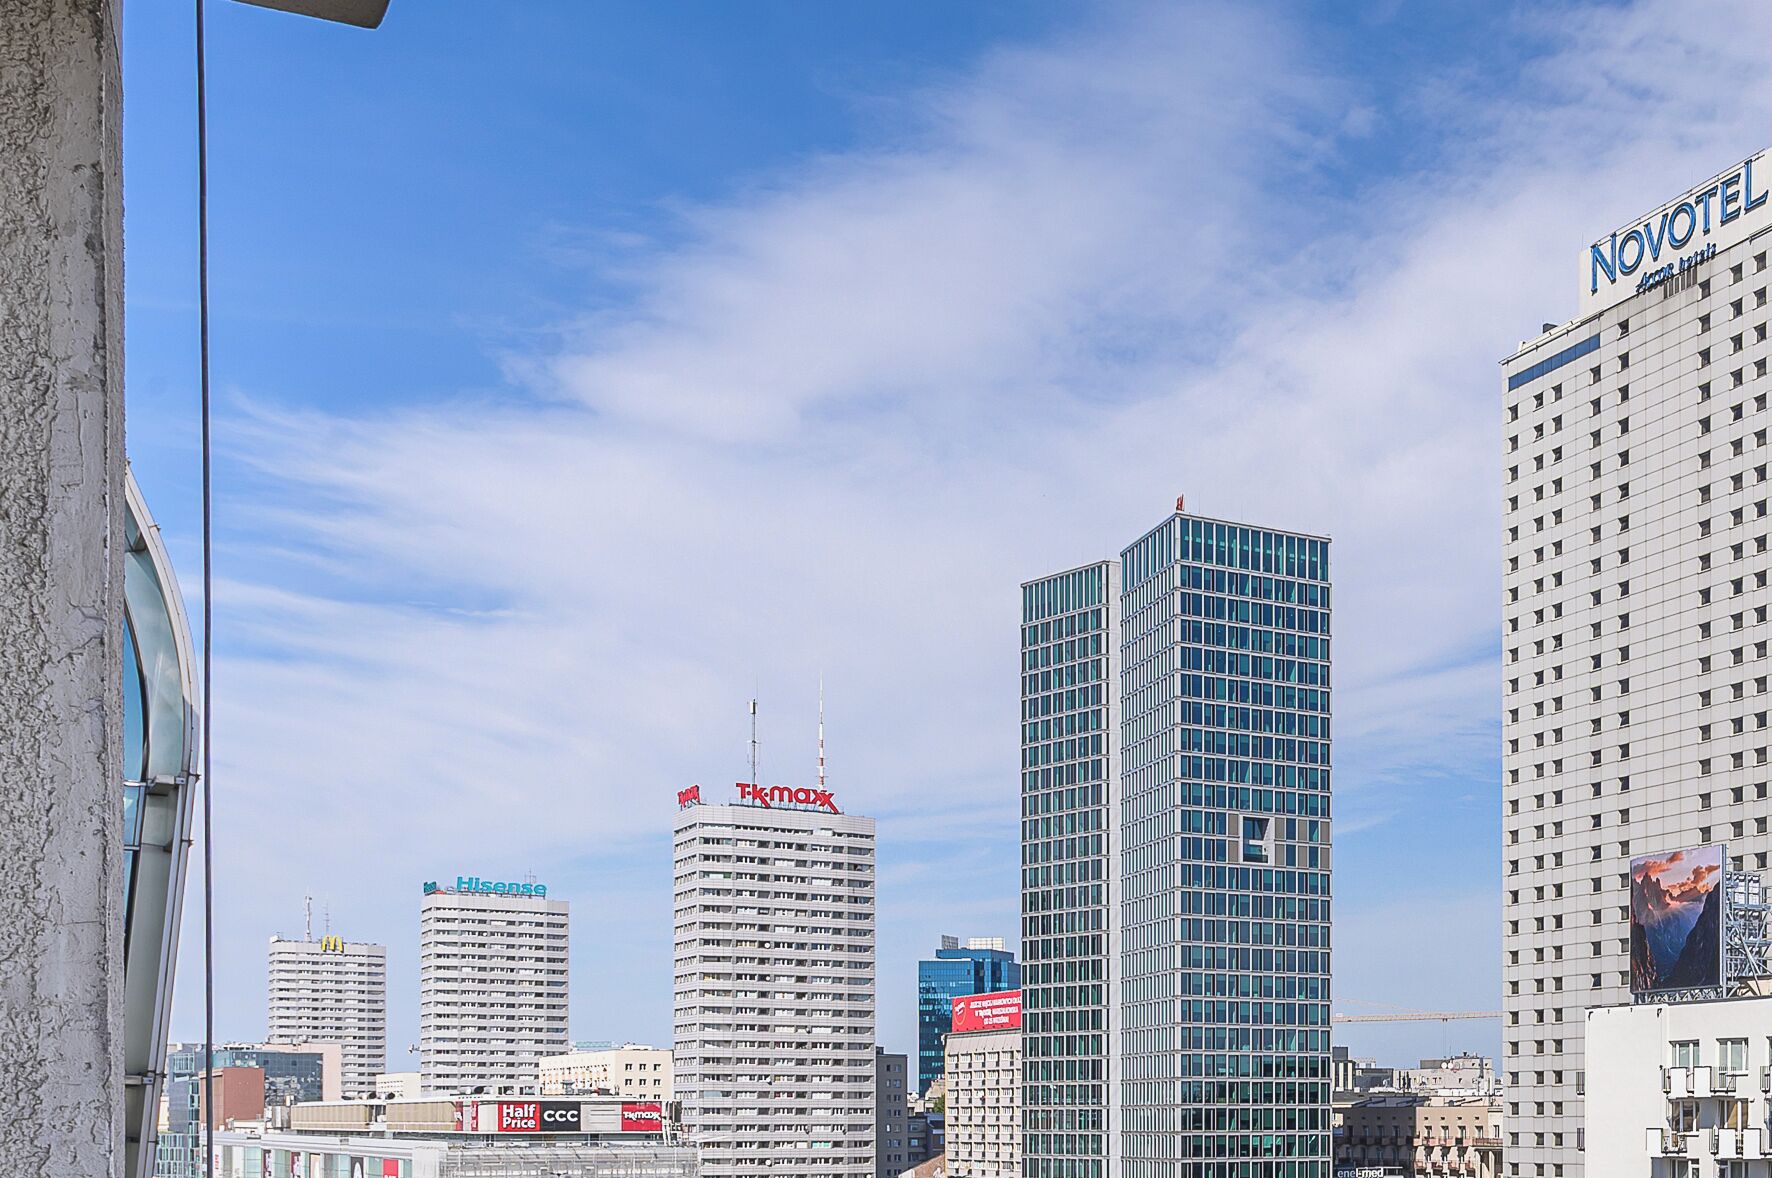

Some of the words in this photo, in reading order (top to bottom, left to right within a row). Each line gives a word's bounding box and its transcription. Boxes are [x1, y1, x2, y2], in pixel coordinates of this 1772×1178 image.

[1591, 159, 1769, 295] NOVOTEL
[457, 876, 547, 894] Hisense
[503, 1104, 535, 1118] Half
[543, 1110, 579, 1122] CCC
[503, 1118, 535, 1129] Price
[1337, 1167, 1384, 1178] enel-med
